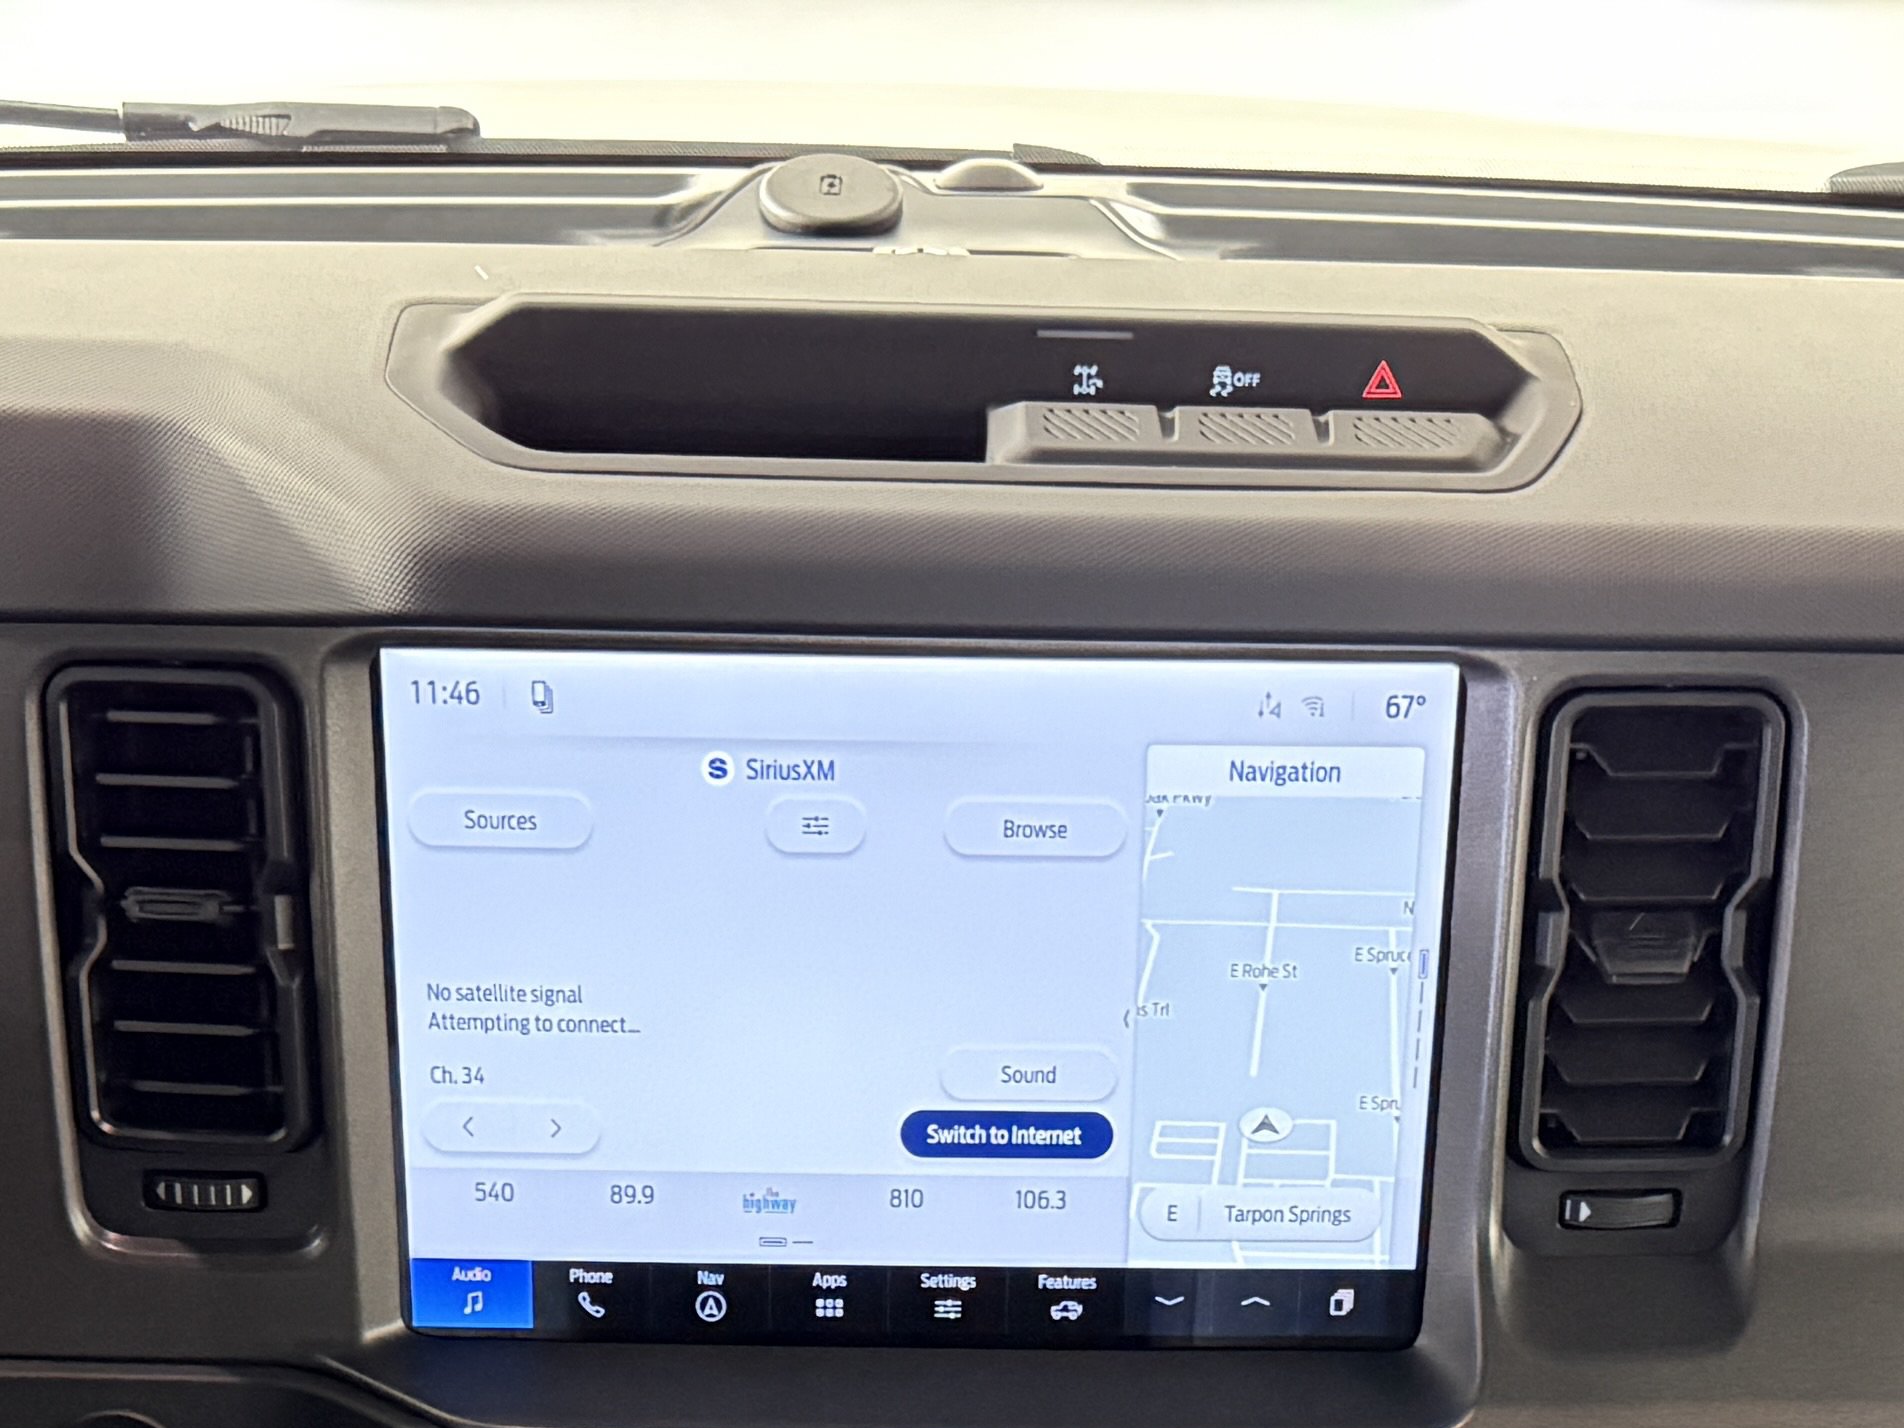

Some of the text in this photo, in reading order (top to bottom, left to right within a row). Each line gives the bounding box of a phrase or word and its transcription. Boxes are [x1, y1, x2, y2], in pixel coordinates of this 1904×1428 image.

[1233, 371, 1261, 387] OFF
[410, 679, 481, 705] 11:46
[1386, 694, 1427, 719] 67°
[746, 758, 836, 782] SiriusXM
[1229, 759, 1342, 787] Navigation
[464, 809, 537, 831] Sources
[1002, 819, 1068, 840] Browse
[1354, 947, 1364, 962] E
[1230, 963, 1239, 978] E
[1283, 964, 1298, 979] St
[427, 983, 583, 1007] No satellite signal
[428, 1012, 530, 1036] Attempting
[535, 1015, 554, 1033] to
[430, 1066, 485, 1085] Ch. 34
[1001, 1065, 1057, 1084] Sound
[1358, 1096, 1367, 1110] E
[926, 1124, 1083, 1146] Switch to Internet
[475, 1182, 515, 1202] 540
[610, 1184, 655, 1204] 89.9
[889, 1188, 924, 1209] 810
[1016, 1189, 1067, 1210] 106.3
[1167, 1205, 1178, 1222] E
[1224, 1205, 1351, 1227] Tarpon Springs
[451, 1266, 492, 1283] Audio
[569, 1268, 614, 1285] Phone
[697, 1270, 725, 1286] Nav
[812, 1272, 847, 1289] Apps
[920, 1273, 977, 1291] Settings
[1038, 1274, 1097, 1291] Features
